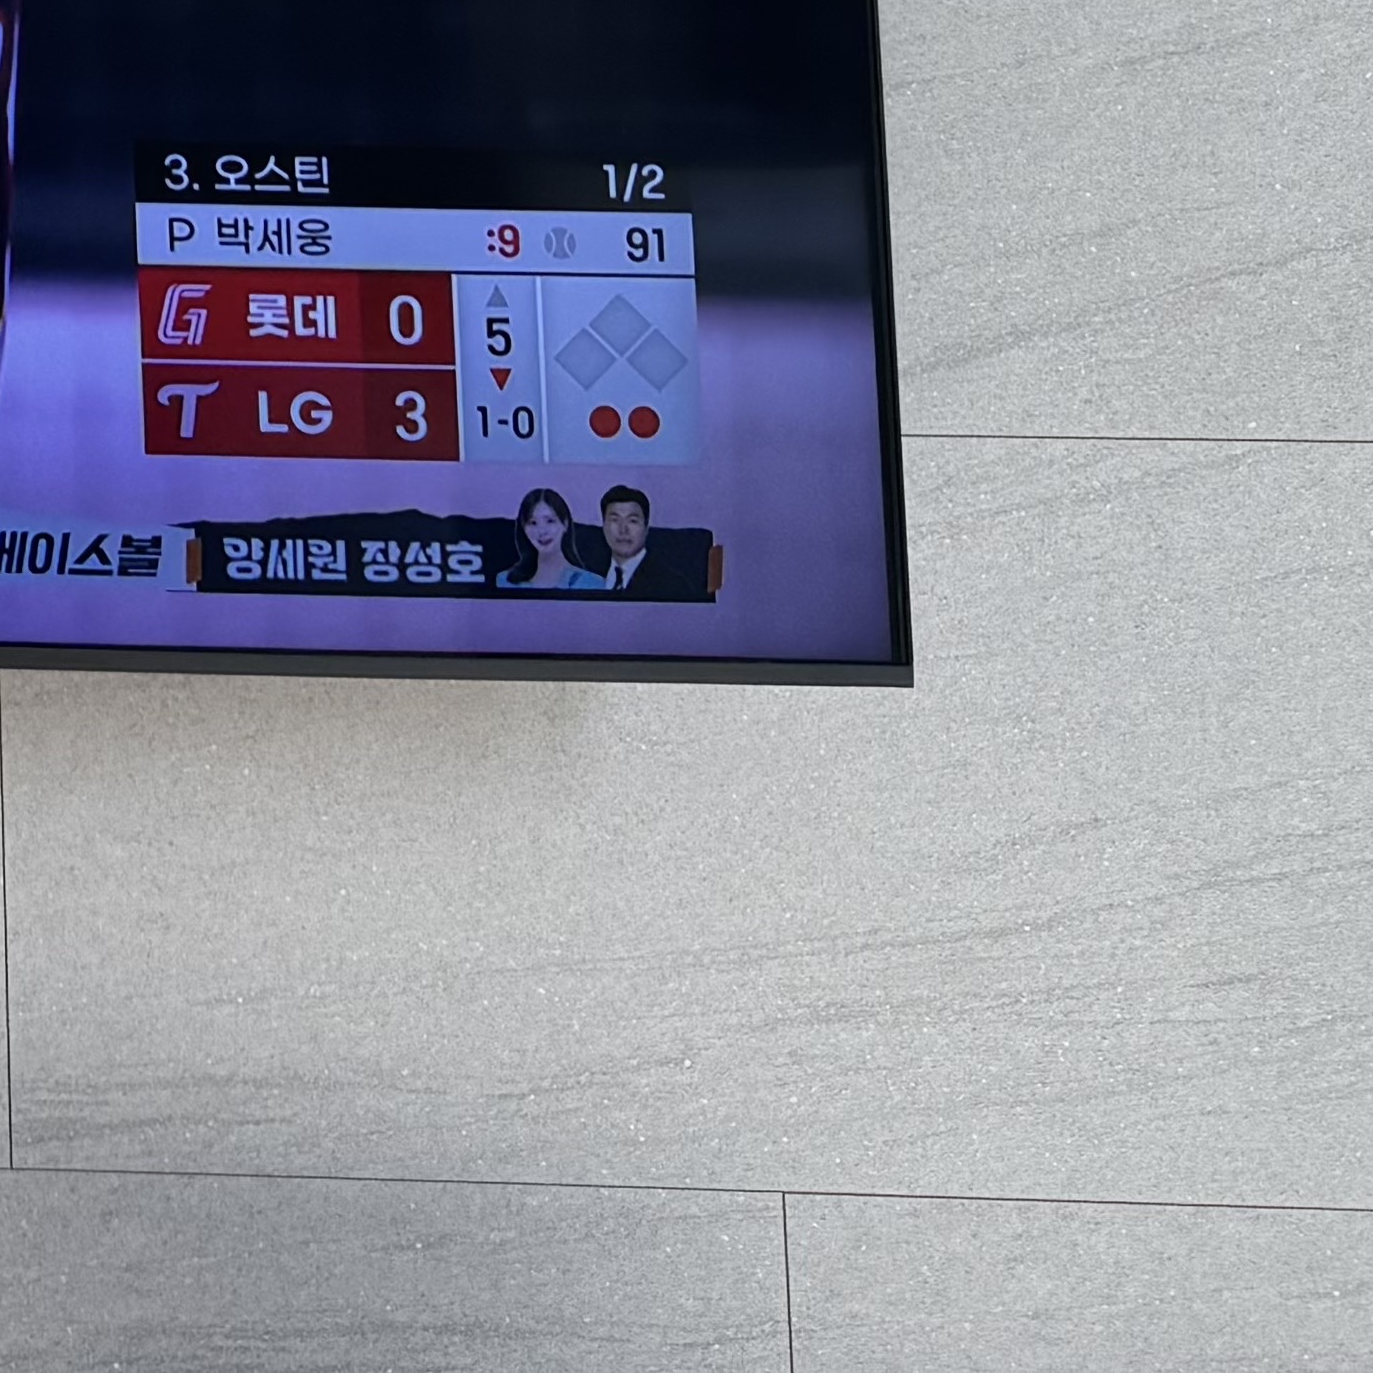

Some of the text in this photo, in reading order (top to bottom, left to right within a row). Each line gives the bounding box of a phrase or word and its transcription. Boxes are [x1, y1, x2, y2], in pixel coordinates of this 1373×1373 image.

[164, 155, 331, 195] 3. 오스틴
[603, 164, 666, 203] 1/2
[168, 217, 333, 257] P 박세웅
[625, 228, 667, 263] 91
[246, 294, 338, 340] 롯데
[389, 295, 424, 346] 0
[486, 317, 513, 357] 5
[258, 391, 333, 435] LG
[395, 391, 428, 442] 3
[475, 406, 535, 440] 1-0
[360, 540, 486, 584] 장성호
